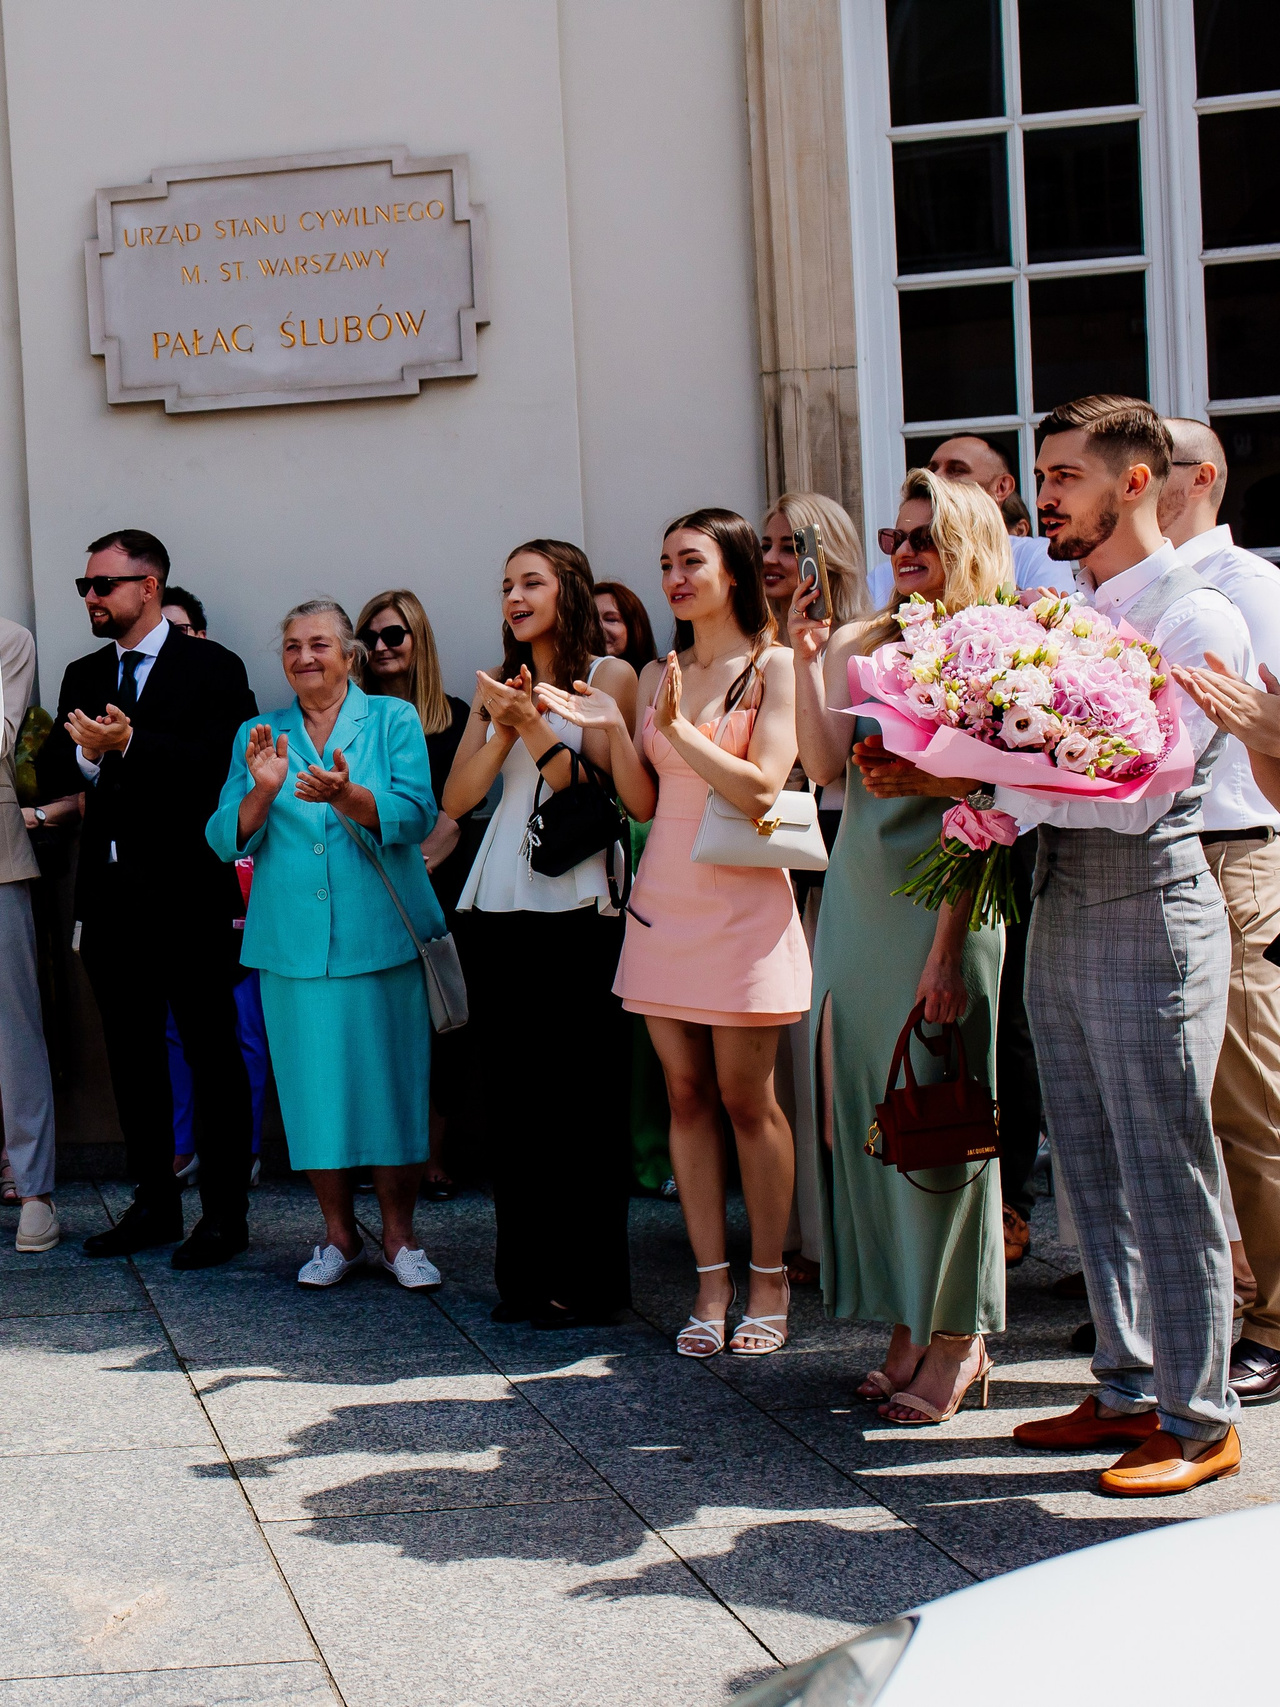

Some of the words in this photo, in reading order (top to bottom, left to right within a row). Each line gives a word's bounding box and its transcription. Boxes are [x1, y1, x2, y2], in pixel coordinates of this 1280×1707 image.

[123, 223, 201, 247] URZĄD
[214, 214, 286, 240] STANU
[299, 200, 445, 232] CYWILNEGO
[181, 264, 208, 285] M.
[220, 261, 249, 282] ST.
[257, 249, 389, 277] WARSZAWY
[152, 324, 255, 359] PAŁAC
[279, 303, 427, 348] ŚLUBÓW
